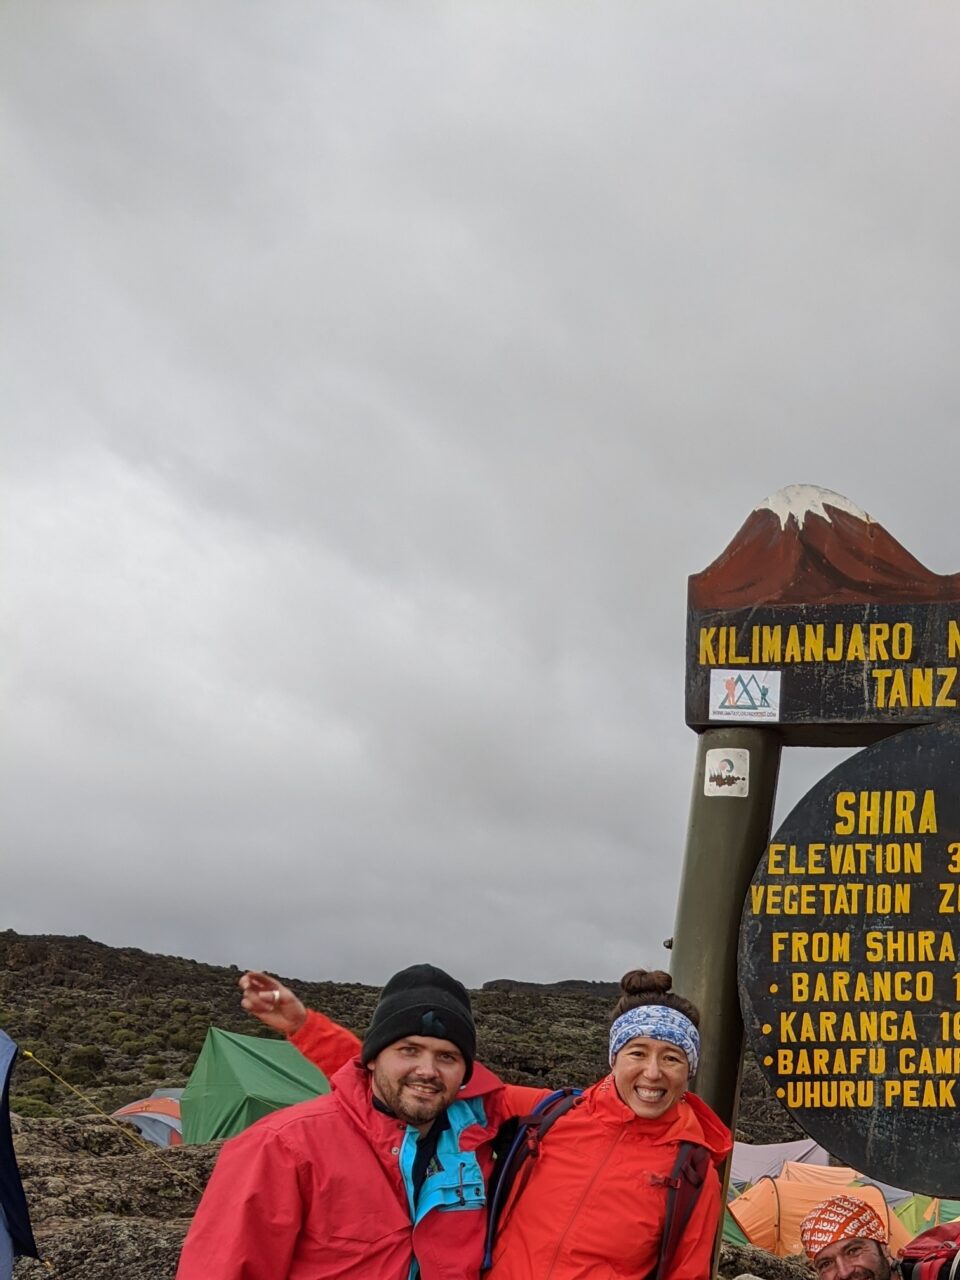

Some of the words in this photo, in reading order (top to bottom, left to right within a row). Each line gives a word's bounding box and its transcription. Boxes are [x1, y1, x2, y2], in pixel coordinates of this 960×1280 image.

[698, 622, 914, 667] KILIMANJARO
[835, 789, 938, 835] SHIRA
[767, 843, 923, 875] ELEVATION
[751, 883, 911, 915] VEGETATION
[772, 931, 851, 963] FROM
[866, 930, 956, 963] SHIRA
[791, 970, 935, 1003] BARANCO
[780, 1010, 918, 1043] KARANGA
[777, 1047, 886, 1075] BARAFU
[787, 1080, 874, 1108] UHURU
[884, 1079, 957, 1108] PEAK
